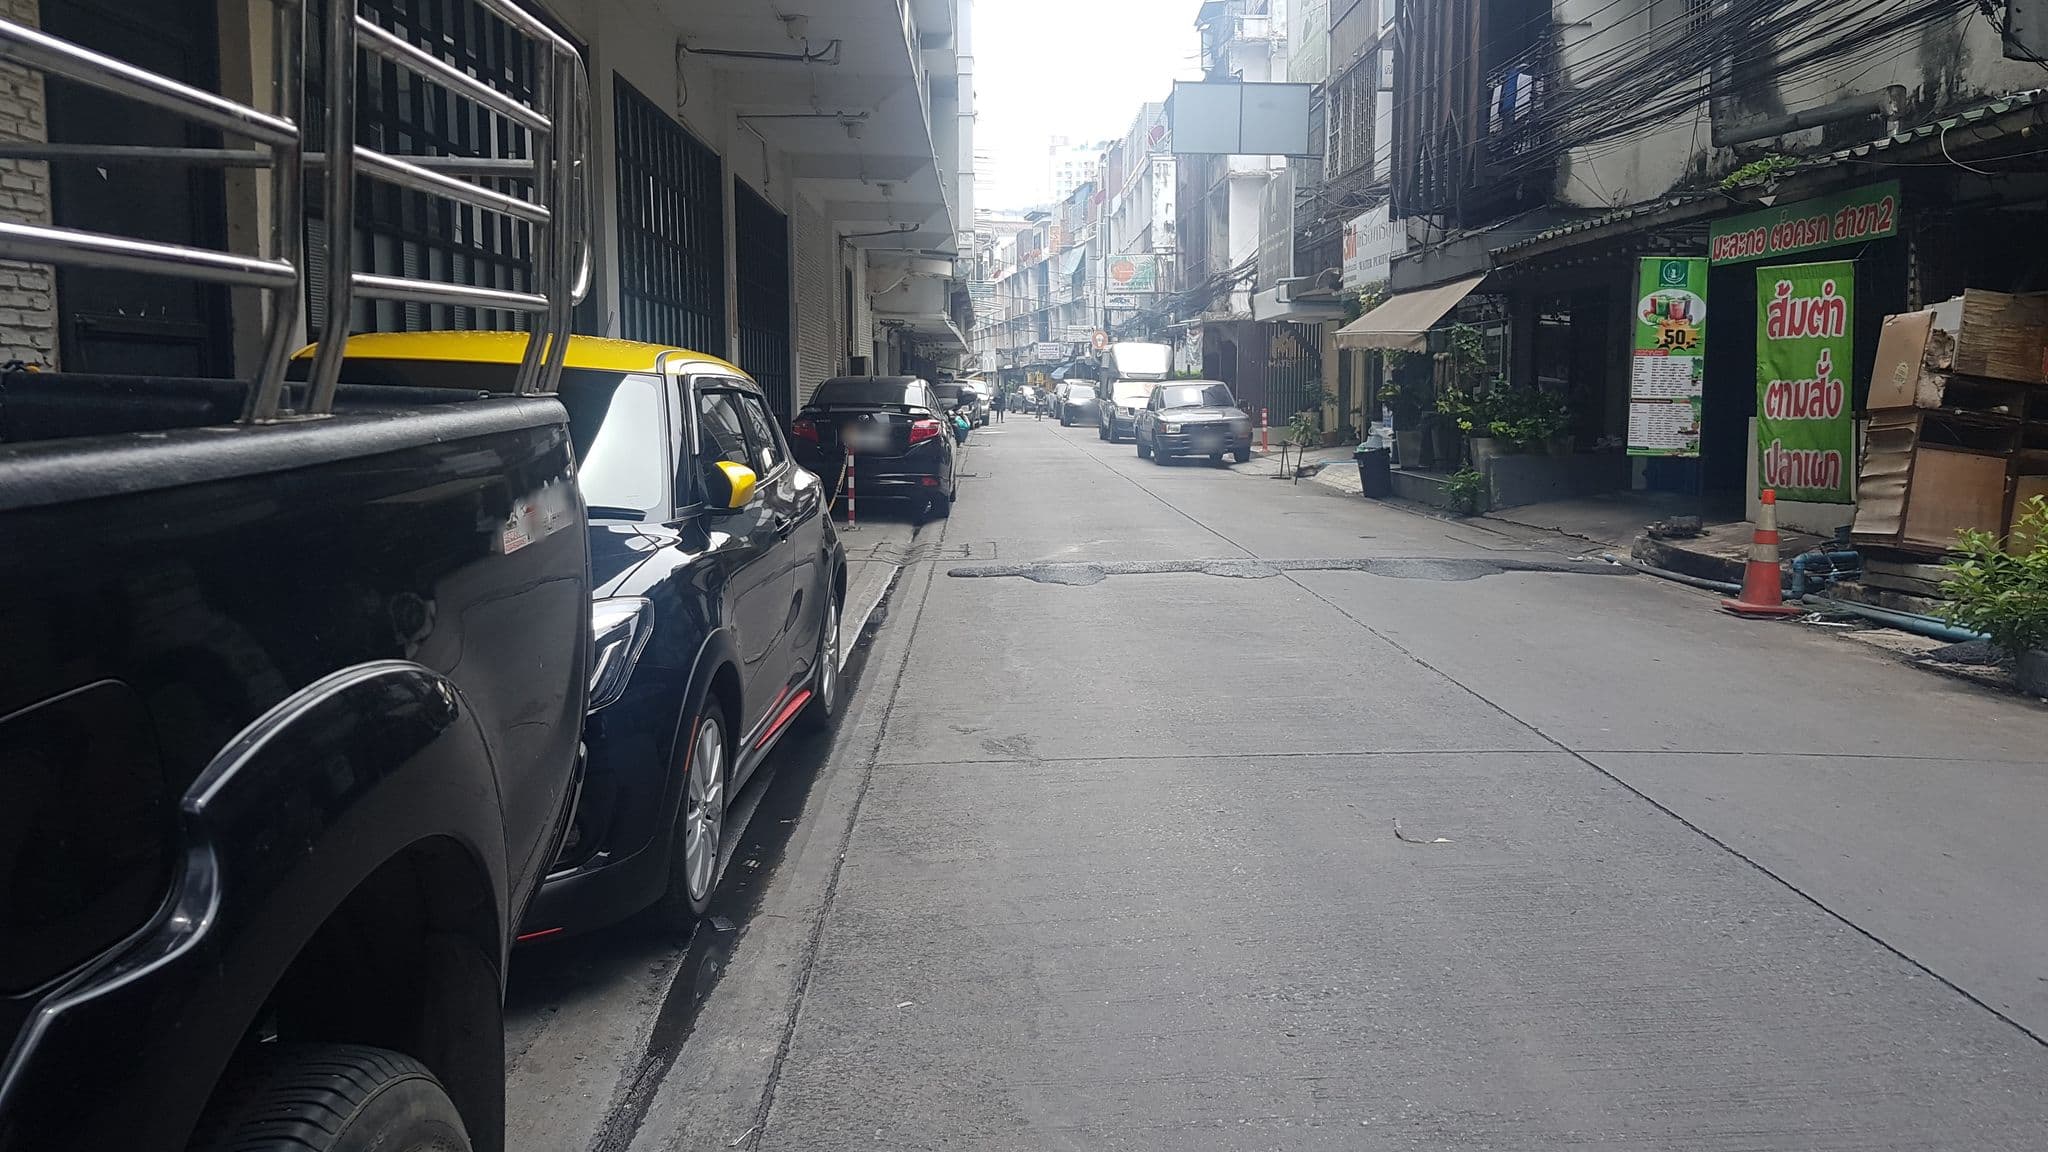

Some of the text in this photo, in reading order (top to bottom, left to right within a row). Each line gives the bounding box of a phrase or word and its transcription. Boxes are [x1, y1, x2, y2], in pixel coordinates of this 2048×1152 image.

[1712, 227, 1768, 262] มะละกอ
[1767, 279, 1847, 340] ส้มตำ
[1765, 348, 1844, 420] ตามสั่ง
[1764, 438, 1843, 489] ปลาเผา
